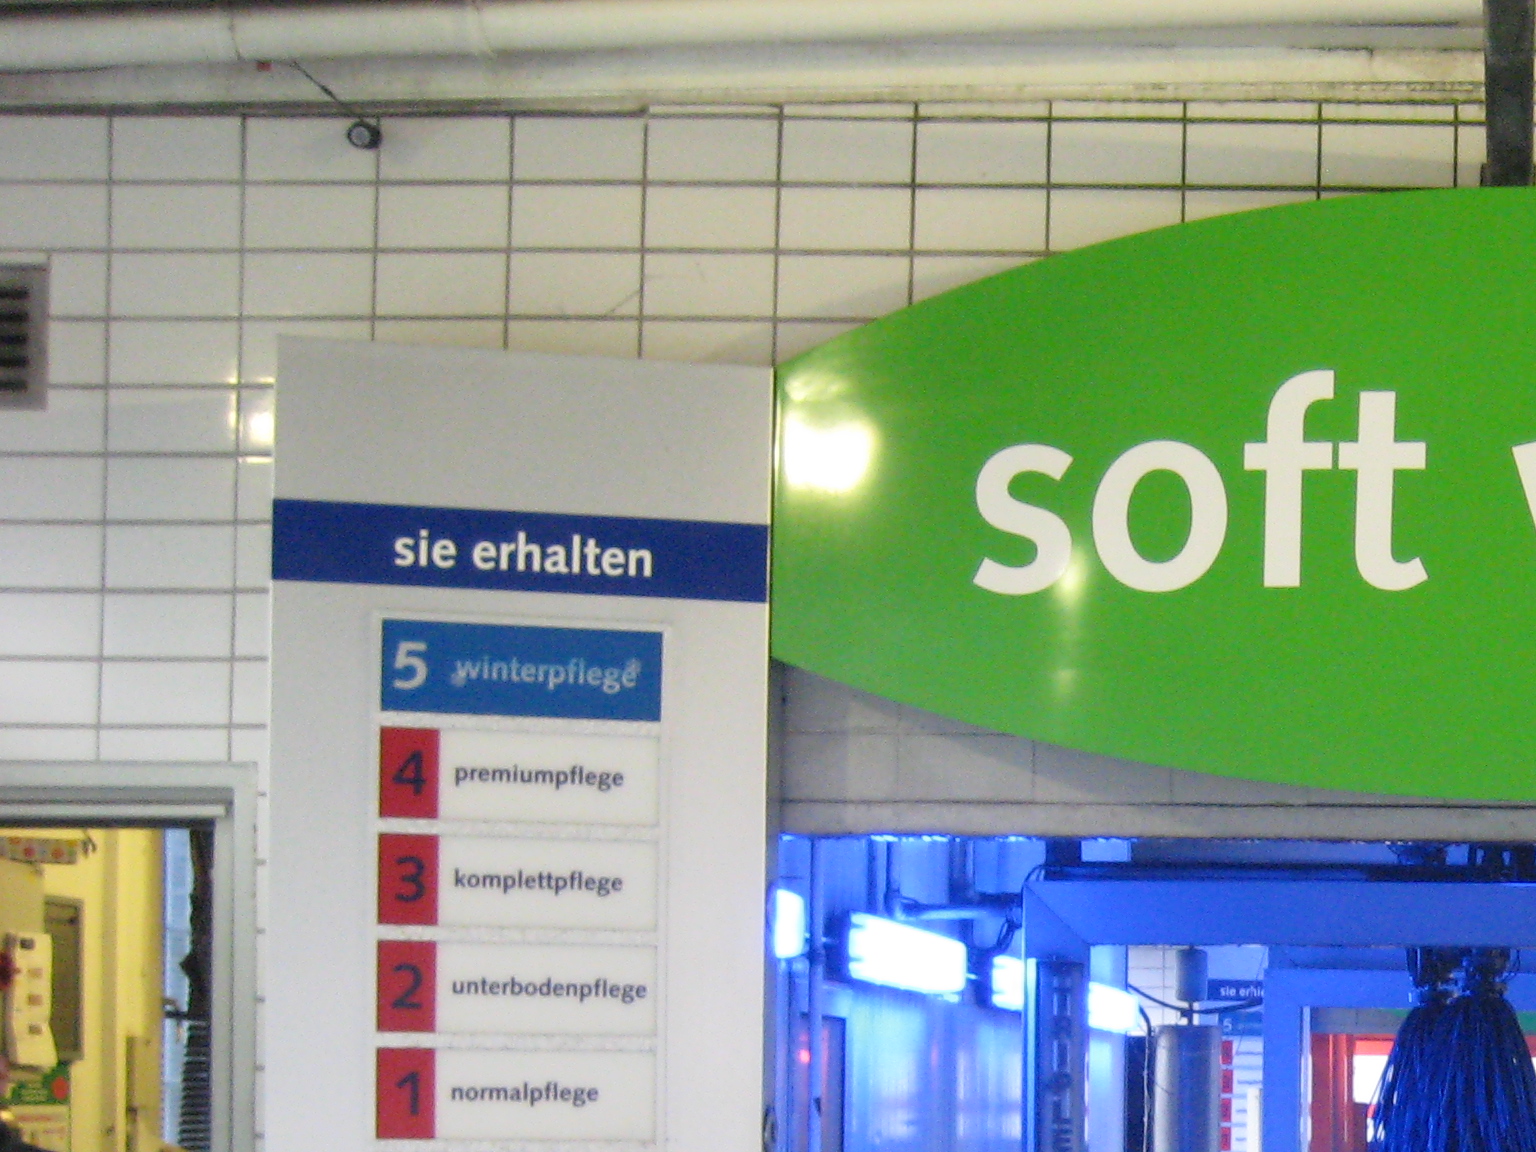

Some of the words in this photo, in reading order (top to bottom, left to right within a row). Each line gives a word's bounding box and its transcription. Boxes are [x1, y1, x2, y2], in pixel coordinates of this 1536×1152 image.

[973, 369, 1428, 598] soft
[395, 529, 456, 568] sie
[472, 531, 652, 577] erhalten
[394, 641, 427, 689] 5
[392, 750, 426, 795] 4
[455, 765, 623, 791] premiumpflege
[396, 856, 426, 903] 3
[454, 868, 622, 897] komplettpflege
[392, 963, 422, 1009] 2
[452, 977, 646, 1004] unterbodenpflege
[396, 1071, 420, 1115] 1
[451, 1082, 598, 1107] normalpflege
